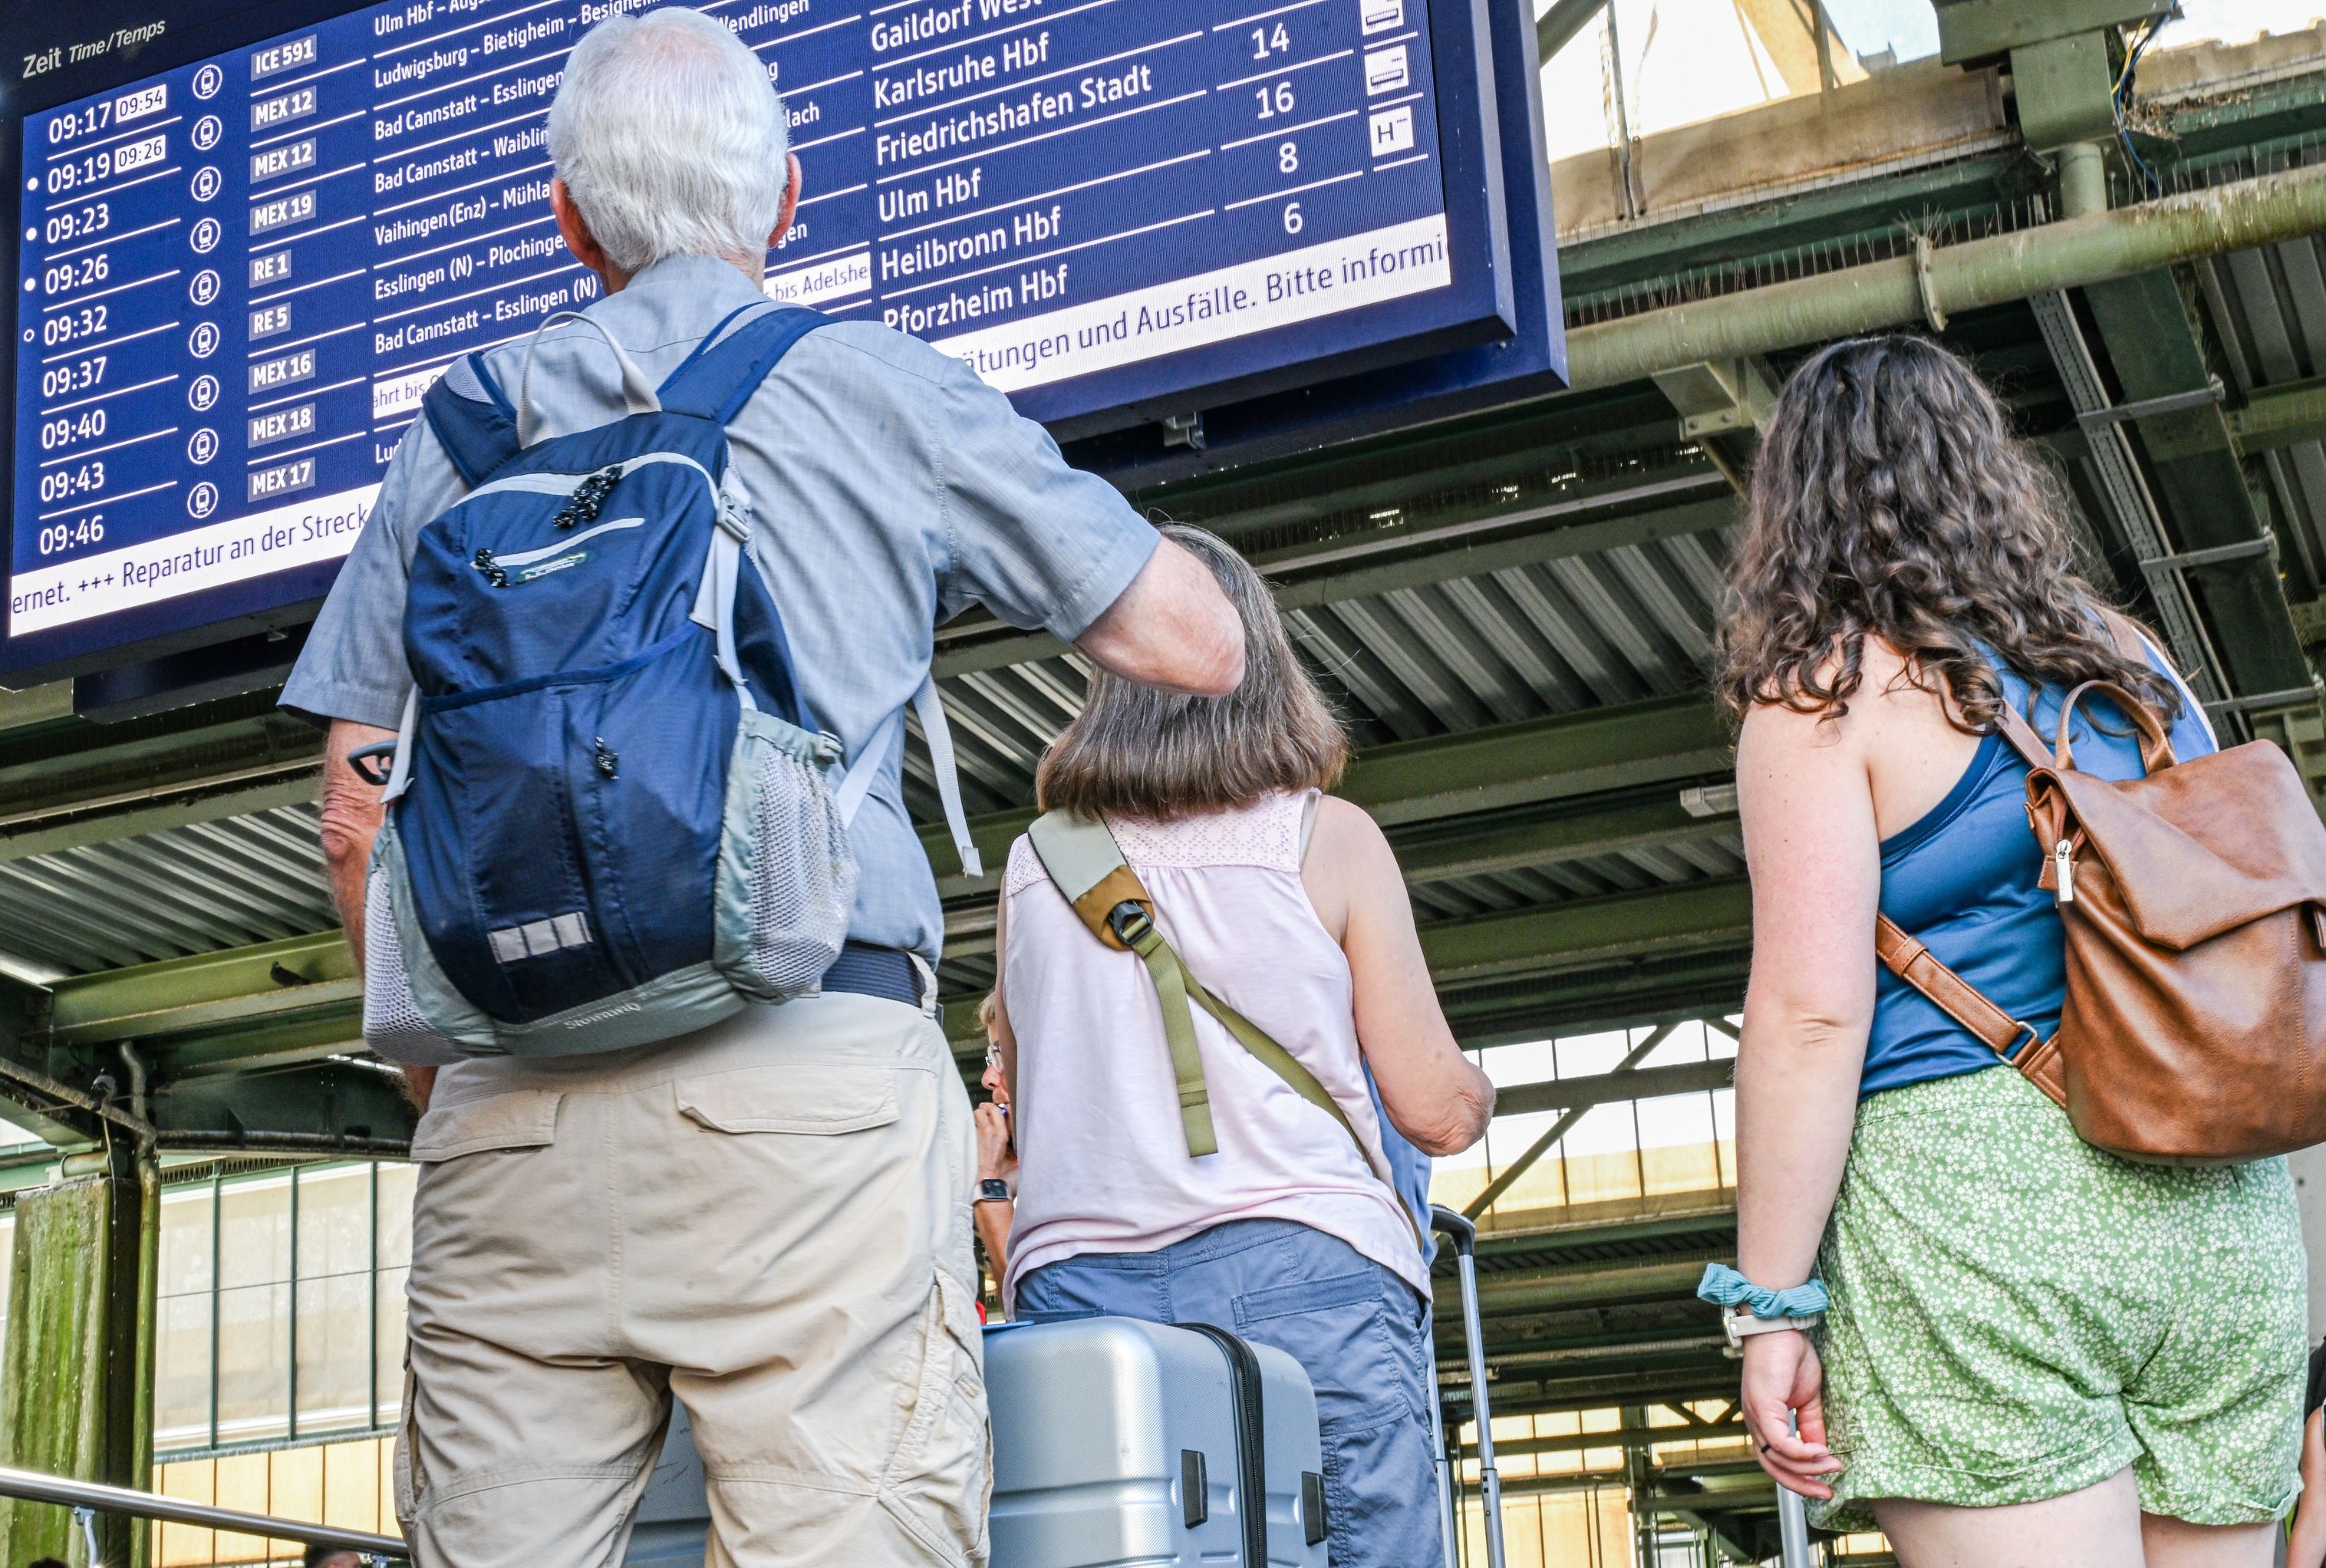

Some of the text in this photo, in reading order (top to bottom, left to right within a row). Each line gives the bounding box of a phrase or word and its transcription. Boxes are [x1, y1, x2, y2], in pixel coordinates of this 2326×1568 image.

[375, 15, 403, 35] Ulm
[407, 1, 433, 25] Hbf
[870, 0, 971, 51] Gaildorf
[23, 19, 166, 78] Zeit Time/Temps
[256, 40, 313, 73] ICE 591
[375, 48, 466, 87] Ludwigsburg
[484, 18, 564, 54] Bietigheim
[1252, 22, 1289, 59] 14
[875, 32, 1049, 109] Karlsruhe Hbf
[49, 91, 162, 143] 09:17 09:54
[256, 91, 311, 124] MEX 12
[375, 115, 402, 140] Bad
[406, 94, 476, 130] Cannstatt
[493, 71, 564, 104] Esslingen
[877, 64, 1151, 165] Friedrichshafen Stadt
[1257, 81, 1293, 119] 16
[48, 140, 162, 193] 09:19 09:26
[255, 143, 311, 176] MEX 12
[376, 168, 402, 193] Bad
[407, 148, 477, 183] Cannstatt
[1280, 142, 1298, 173] 8
[255, 195, 311, 228] MEX 19
[879, 168, 980, 222] Ulm Hbf
[47, 203, 108, 243] 09:23
[375, 213, 447, 245] Vaihingen
[450, 196, 486, 226] (Enz)
[1284, 203, 1303, 234] 6
[881, 206, 1060, 280] Heilbronn Hbf
[46, 254, 108, 294] 09:26
[255, 254, 288, 281] RE 1
[376, 268, 444, 299] Esslingen
[450, 254, 472, 281] (N)
[775, 282, 797, 301] bis
[804, 265, 866, 293] Adelshe
[376, 328, 403, 354] Bad
[407, 310, 478, 344] Cannstatt
[496, 289, 568, 321] Esslingen
[574, 275, 596, 302] (N)
[884, 264, 1067, 334] Pforzheim Hbf
[44, 305, 106, 345] 09:32
[255, 307, 287, 334] RE 5
[43, 357, 107, 397] 09:37
[254, 354, 311, 387] MEX 16
[13, 582, 69, 614] ernet.
[124, 545, 223, 587] Reparatur
[231, 538, 253, 559] an
[262, 525, 295, 551] der
[303, 503, 366, 542] Streck
[1079, 311, 1127, 348] und
[1138, 286, 1255, 334] Ausfälle.
[1267, 268, 1332, 302] Bitte
[1343, 235, 1441, 284] informi
[42, 410, 105, 449] 09:40
[254, 408, 311, 440] MEX 18
[41, 463, 104, 502] 09:43
[253, 462, 310, 494] MEX 17
[40, 515, 104, 555] 09:46
